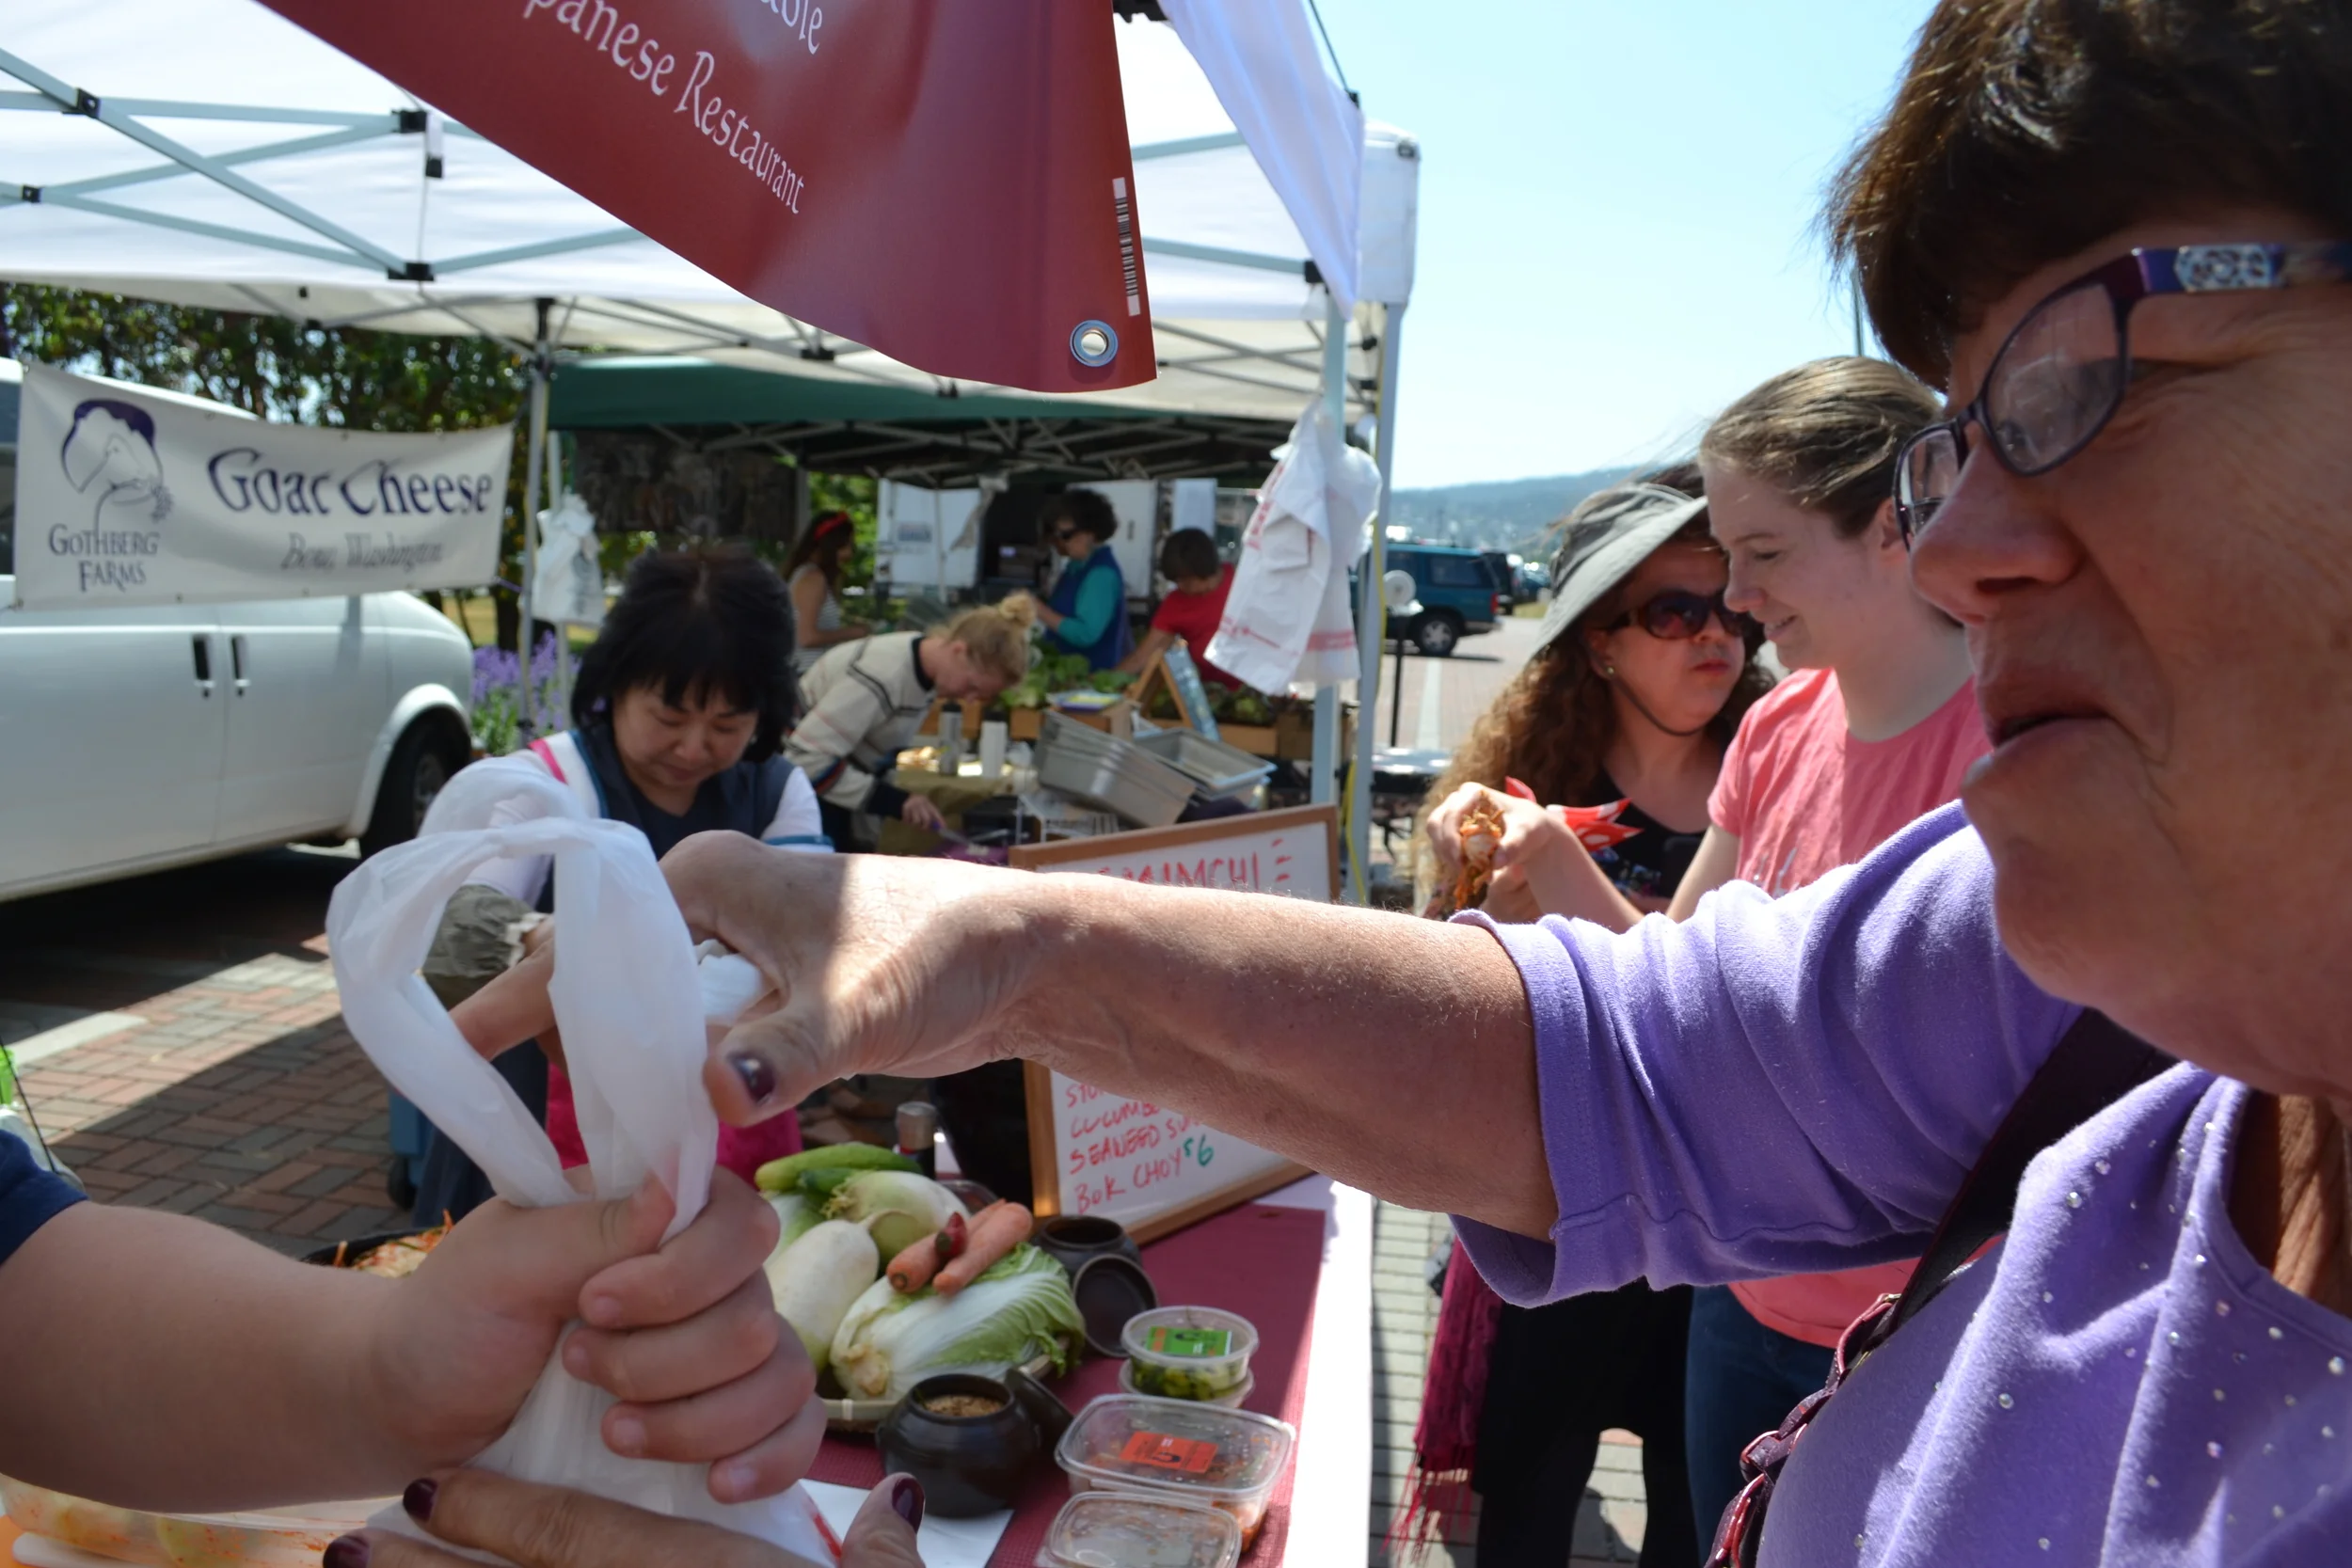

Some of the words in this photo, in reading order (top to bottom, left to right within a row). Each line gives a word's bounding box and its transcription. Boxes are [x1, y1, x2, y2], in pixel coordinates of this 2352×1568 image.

[673, 50, 805, 214] Restaurant
[339, 457, 493, 515] Cheese
[49, 523, 160, 556] GOTHBERG
[78, 561, 147, 593] FARMS
[1070, 1125, 1160, 1175] SEAWEED
[1133, 1147, 1182, 1188] CHOY
